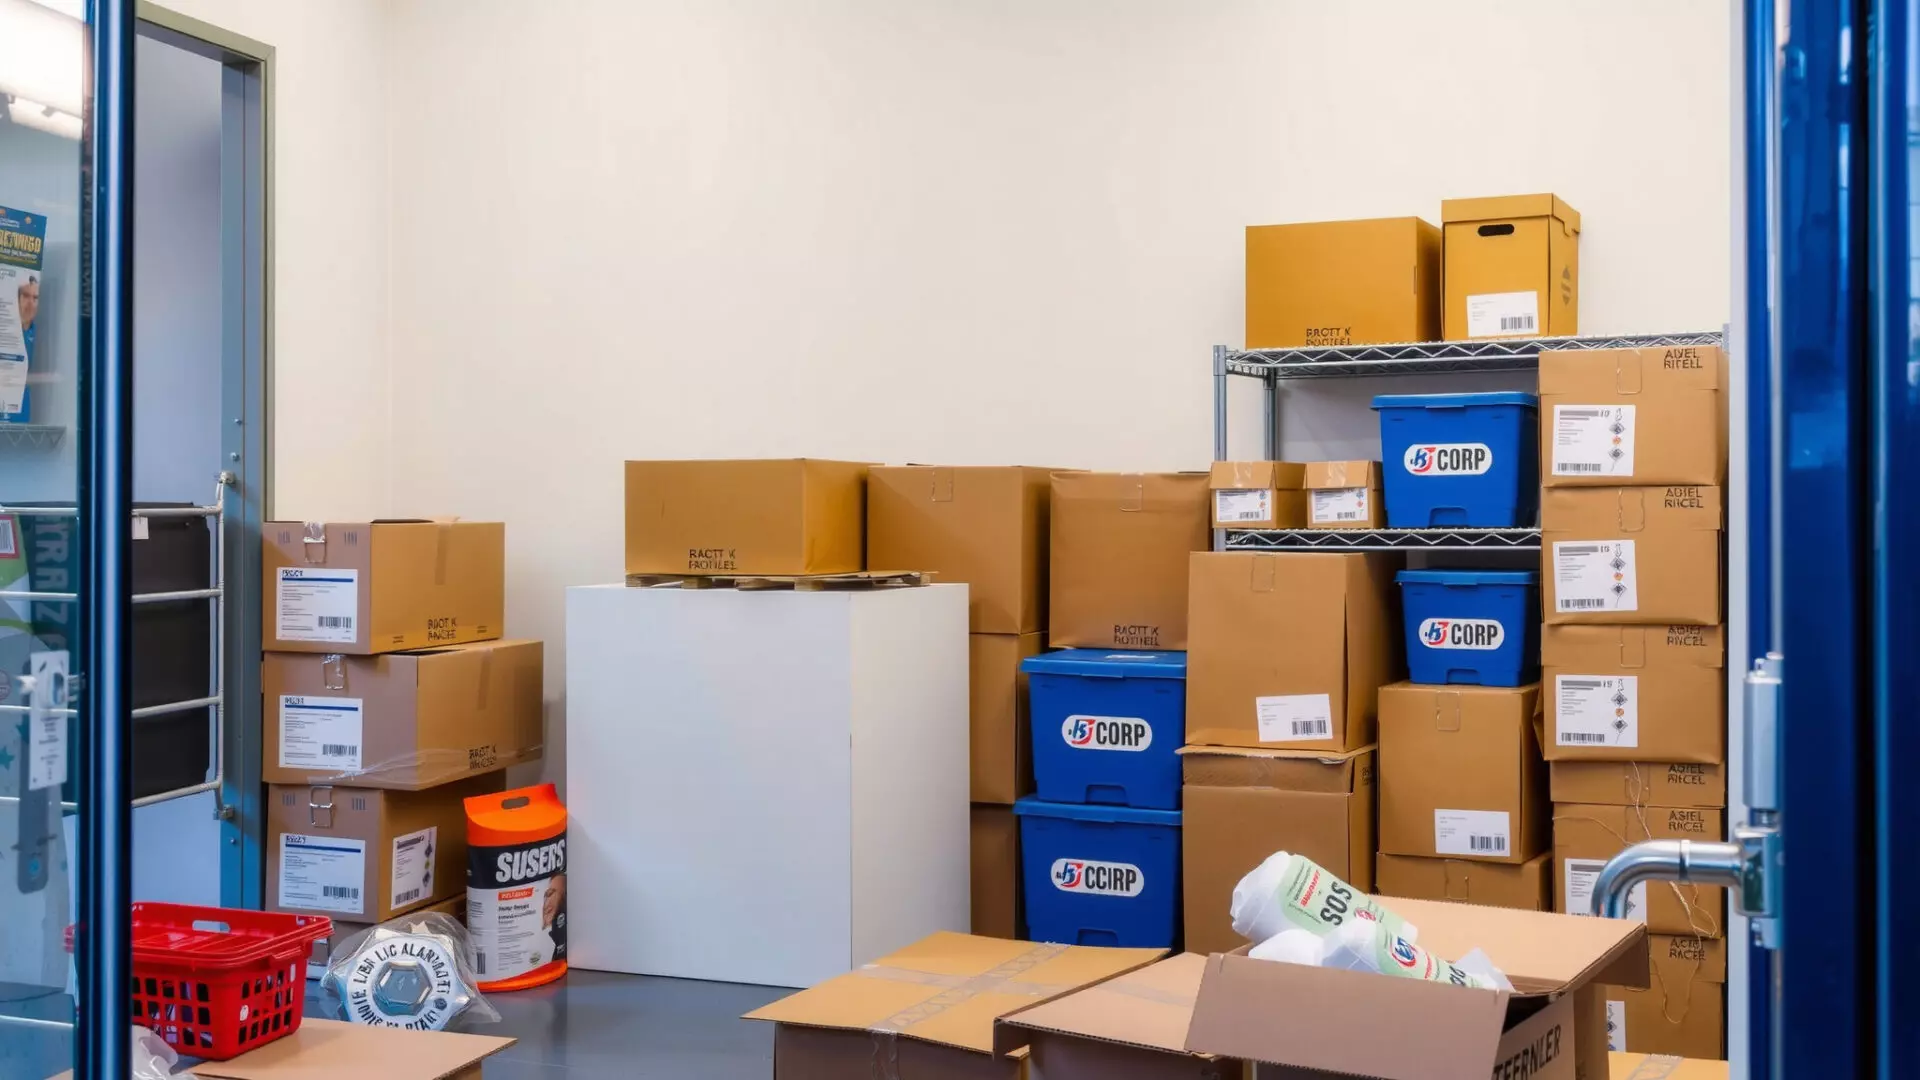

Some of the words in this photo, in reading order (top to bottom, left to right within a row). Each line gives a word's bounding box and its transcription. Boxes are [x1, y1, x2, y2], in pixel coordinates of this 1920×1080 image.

[1437, 448, 1485, 472] CORP
[1451, 623, 1498, 646] CORP
[1096, 721, 1145, 747] CORP
[495, 838, 566, 884] SUSERS
[1319, 880, 1353, 927] SOS
